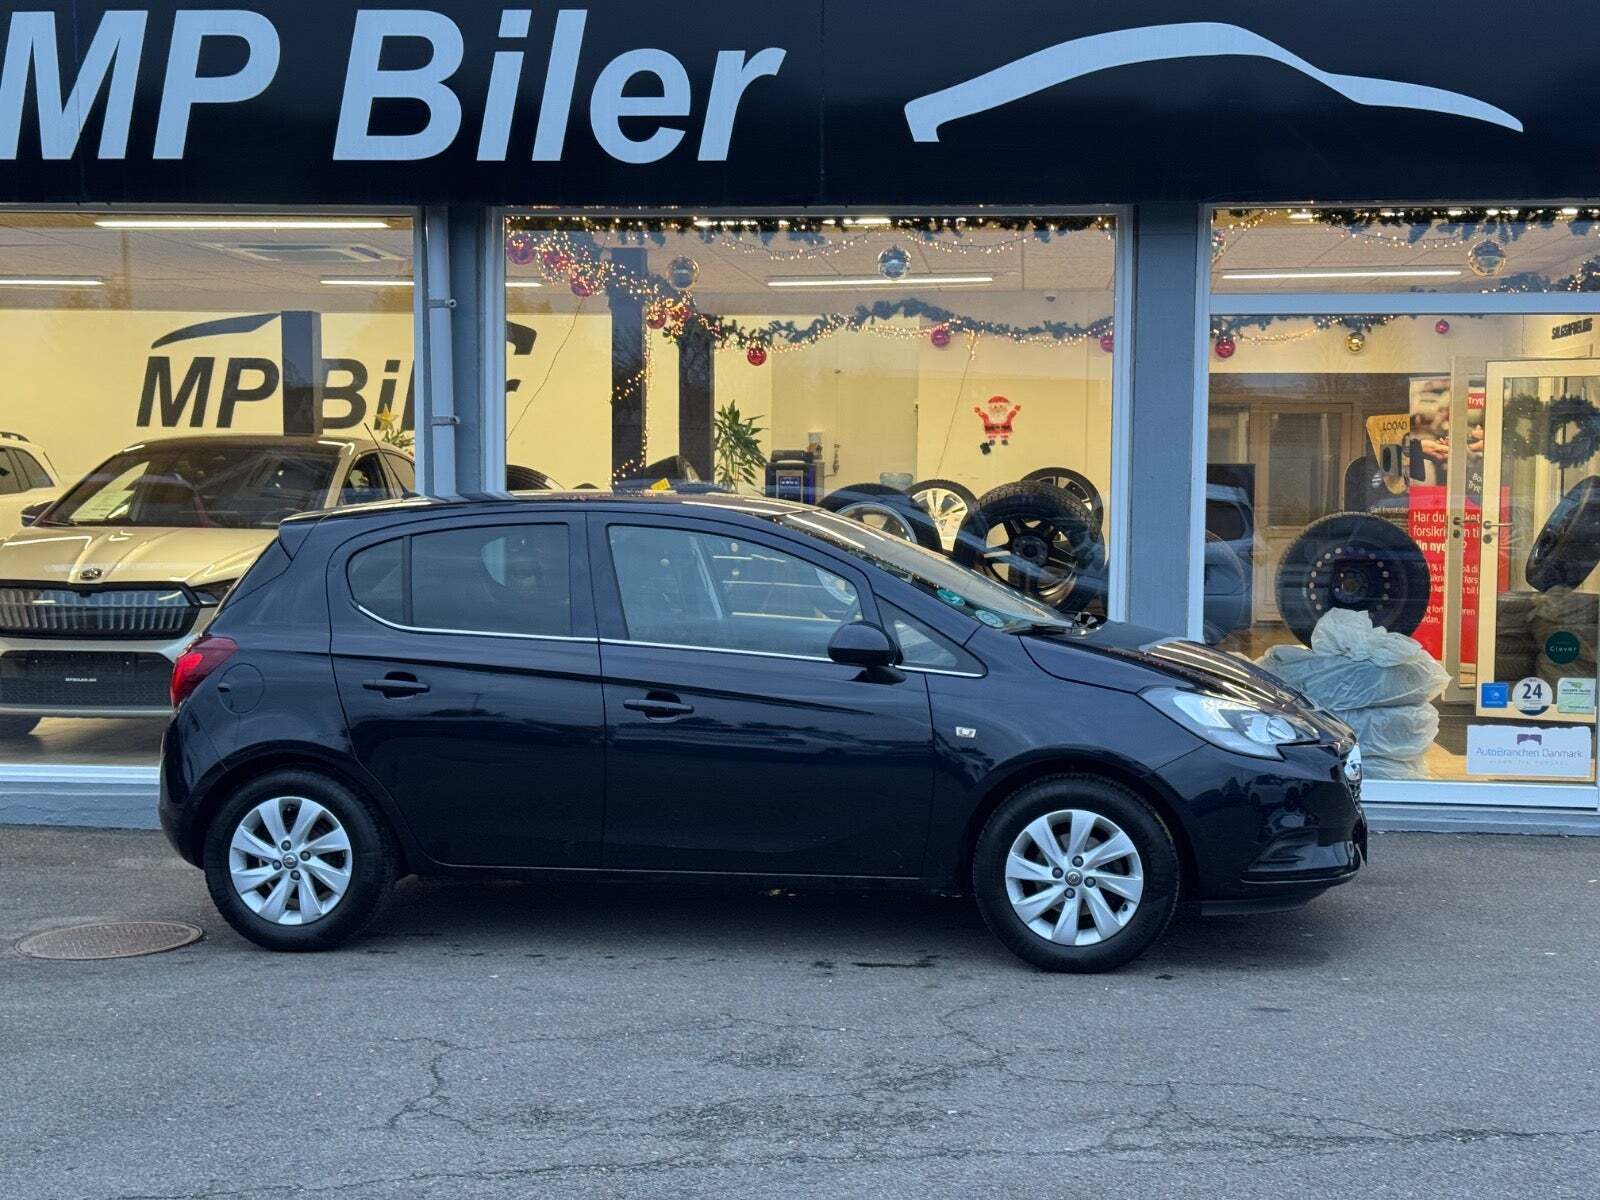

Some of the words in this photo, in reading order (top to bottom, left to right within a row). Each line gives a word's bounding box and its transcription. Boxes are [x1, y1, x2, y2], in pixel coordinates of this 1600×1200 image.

[0, 10, 281, 160] MP
[333, 9, 788, 164] Biler
[136, 356, 281, 428] MP
[1413, 511, 1430, 523] Har
[1432, 511, 1445, 523] du
[1522, 683, 1543, 700] 24
[1476, 746, 1540, 758] AutoBranchen
[1541, 748, 1584, 760] Danmark
